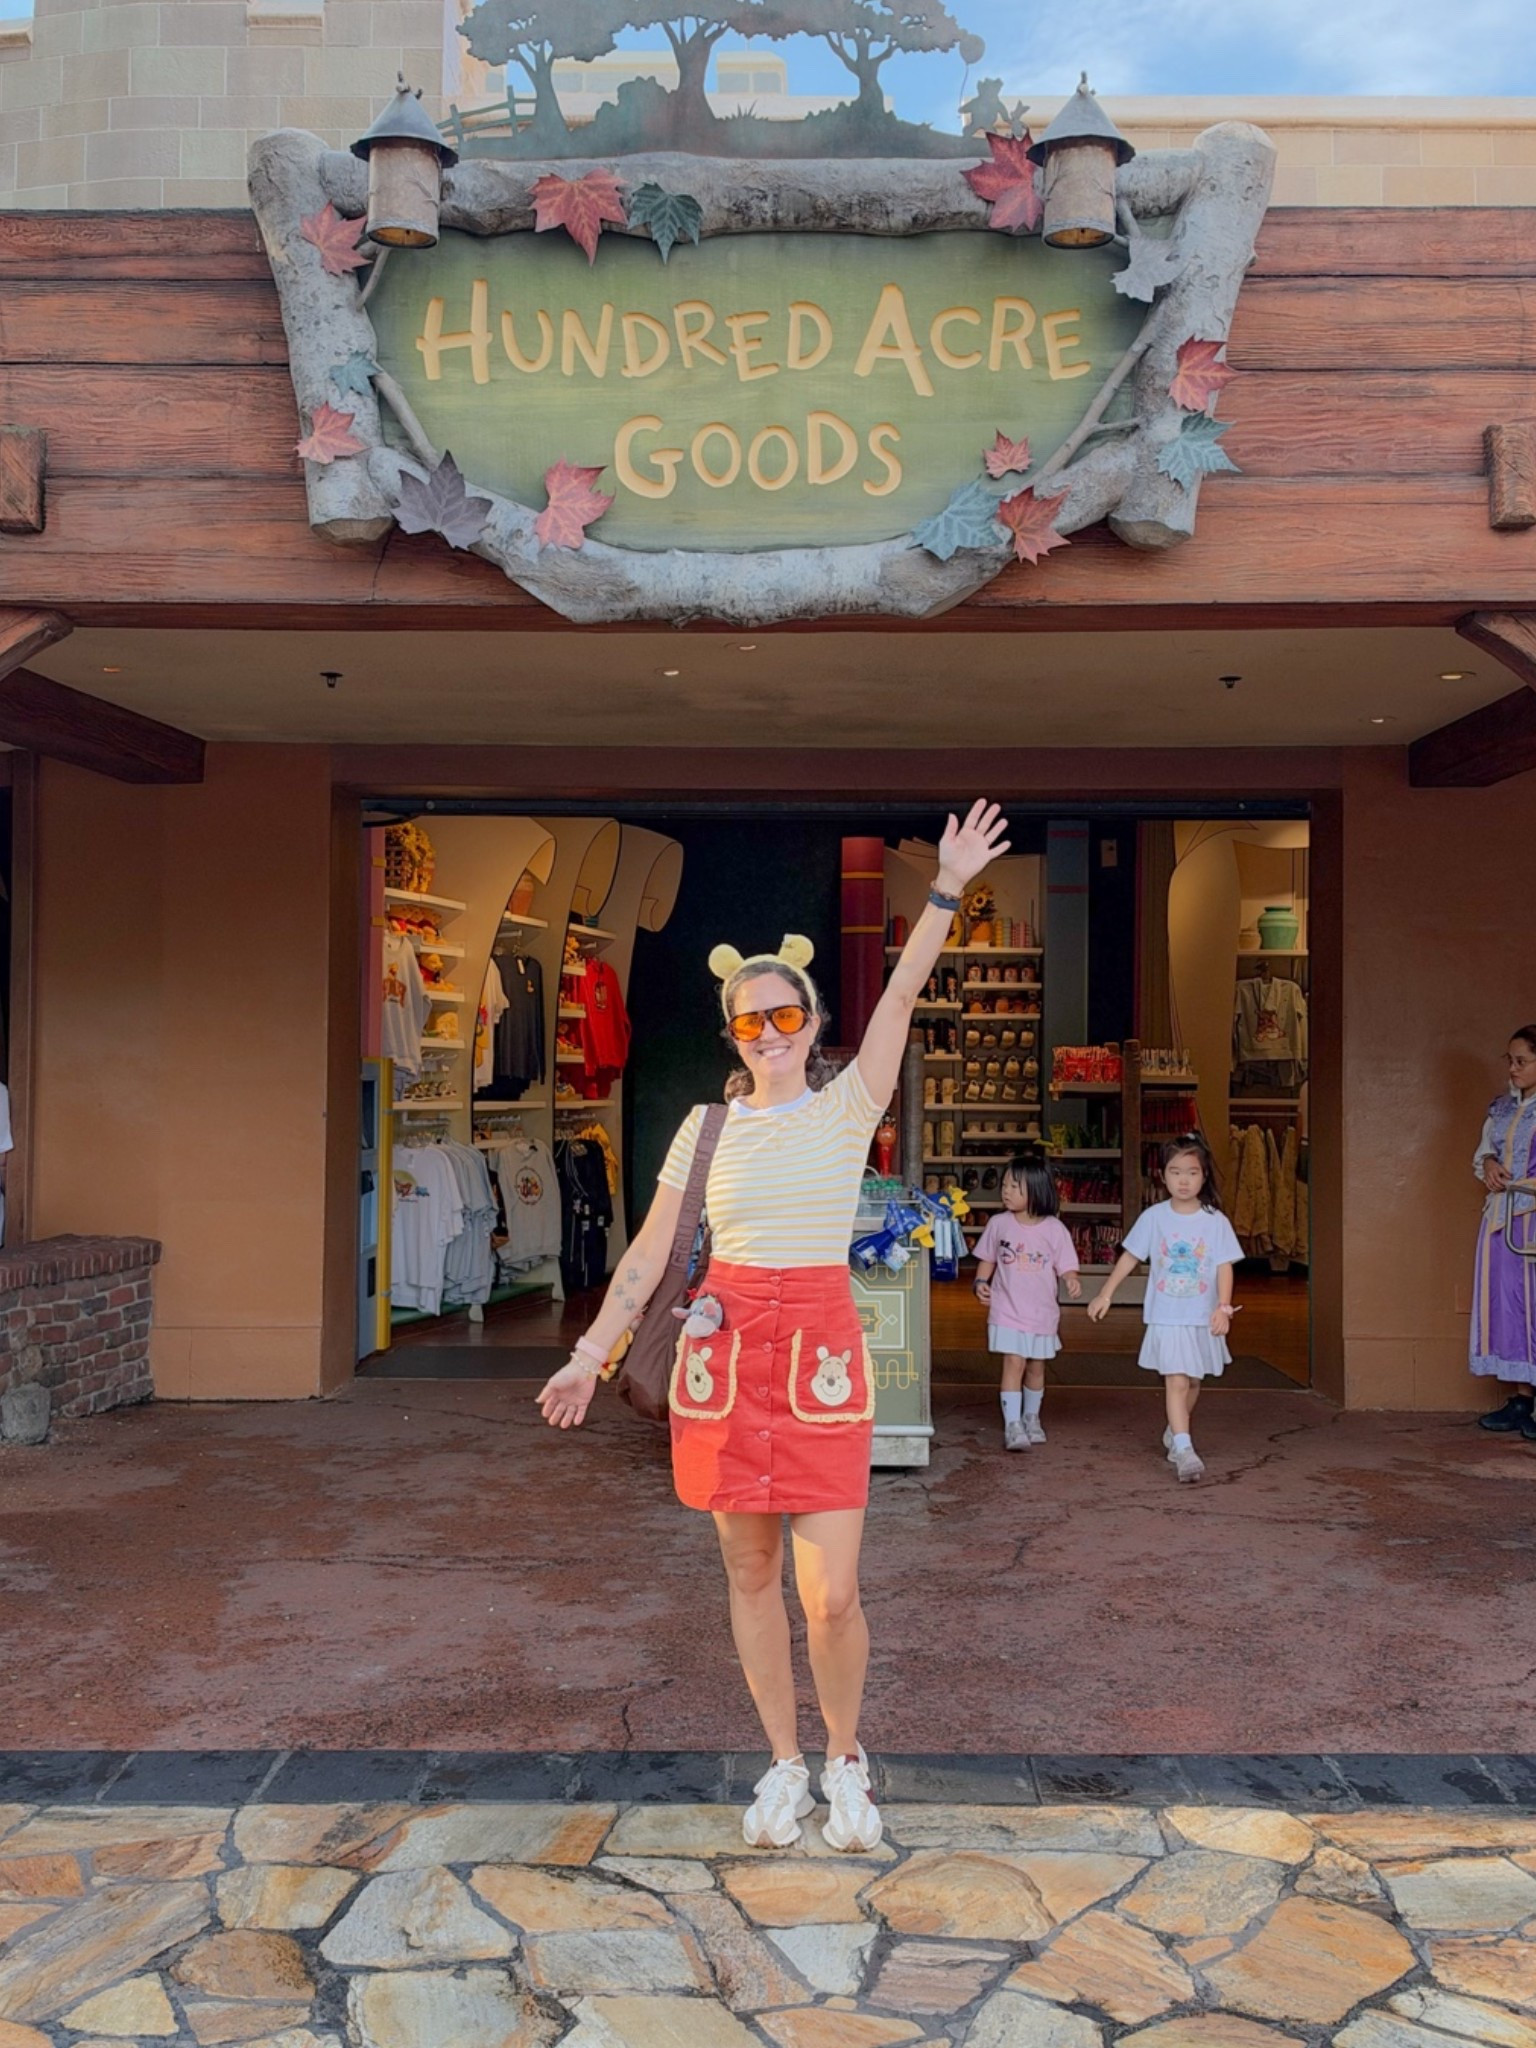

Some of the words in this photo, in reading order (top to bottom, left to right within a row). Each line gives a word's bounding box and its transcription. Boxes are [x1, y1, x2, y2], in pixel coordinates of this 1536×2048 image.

[415, 278, 834, 385] HUNDRED
[853, 283, 1091, 397] ACRE
[613, 411, 902, 499] GOODS
[686, 1149, 711, 1216] BAGGU
